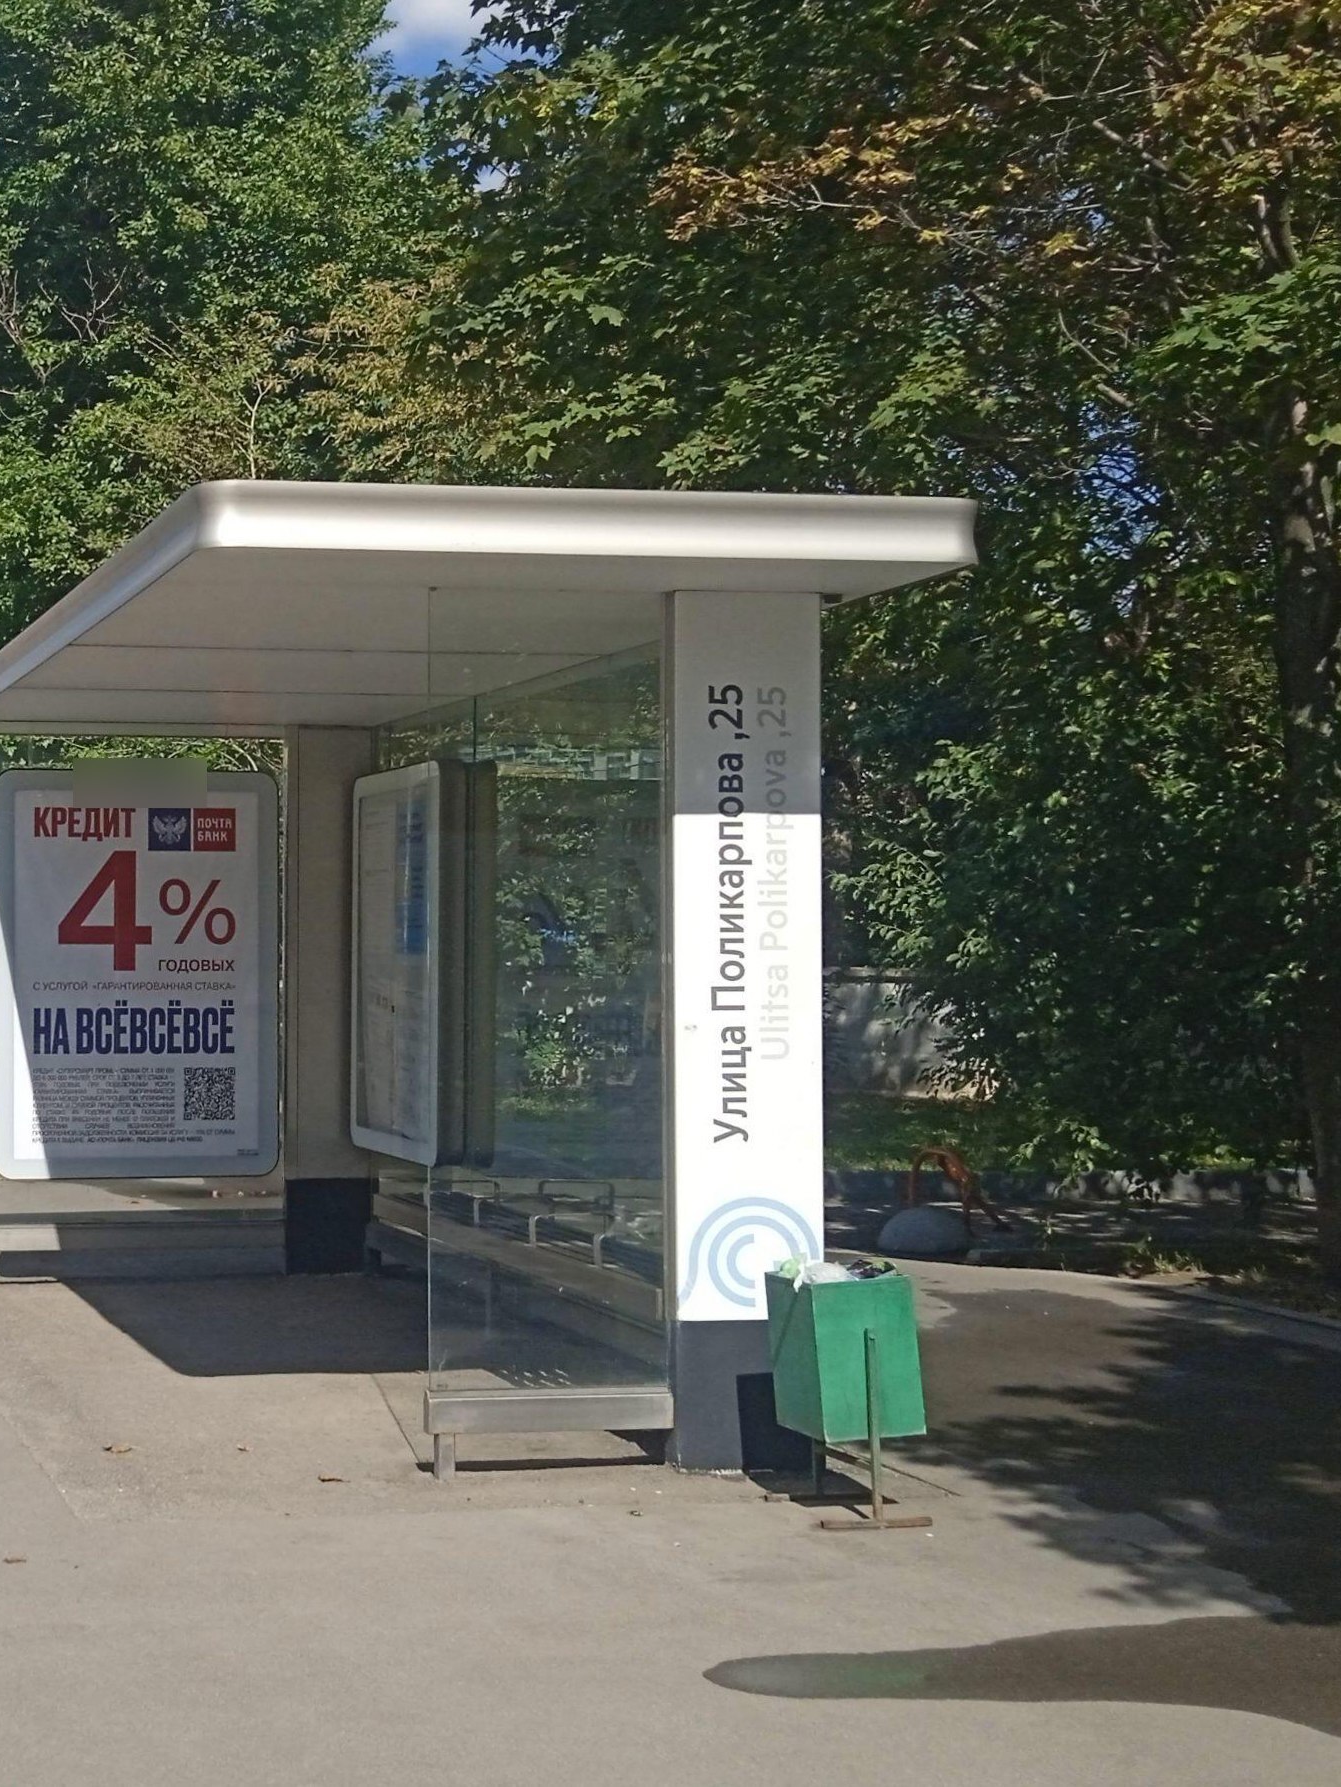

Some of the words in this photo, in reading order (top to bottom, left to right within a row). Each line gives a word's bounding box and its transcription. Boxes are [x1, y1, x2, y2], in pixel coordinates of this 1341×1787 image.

[34, 807, 136, 841] КРЕДИТ
[197, 818, 232, 829] ПОЧТА
[197, 831, 228, 842] БАНК
[757, 750, 793, 951] Polikarpova
[711, 753, 752, 1011] Поликарпова
[32, 982, 40, 991] С
[43, 981, 88, 991] УСЛУГОЙ
[158, 959, 235, 974] ГОДОВЫХ
[33, 1007, 70, 1054] НА
[76, 1000, 235, 1055] ВСЁВСЁВСЁ
[759, 964, 790, 1060] Ulitsa
[713, 1026, 752, 1143] Улица
